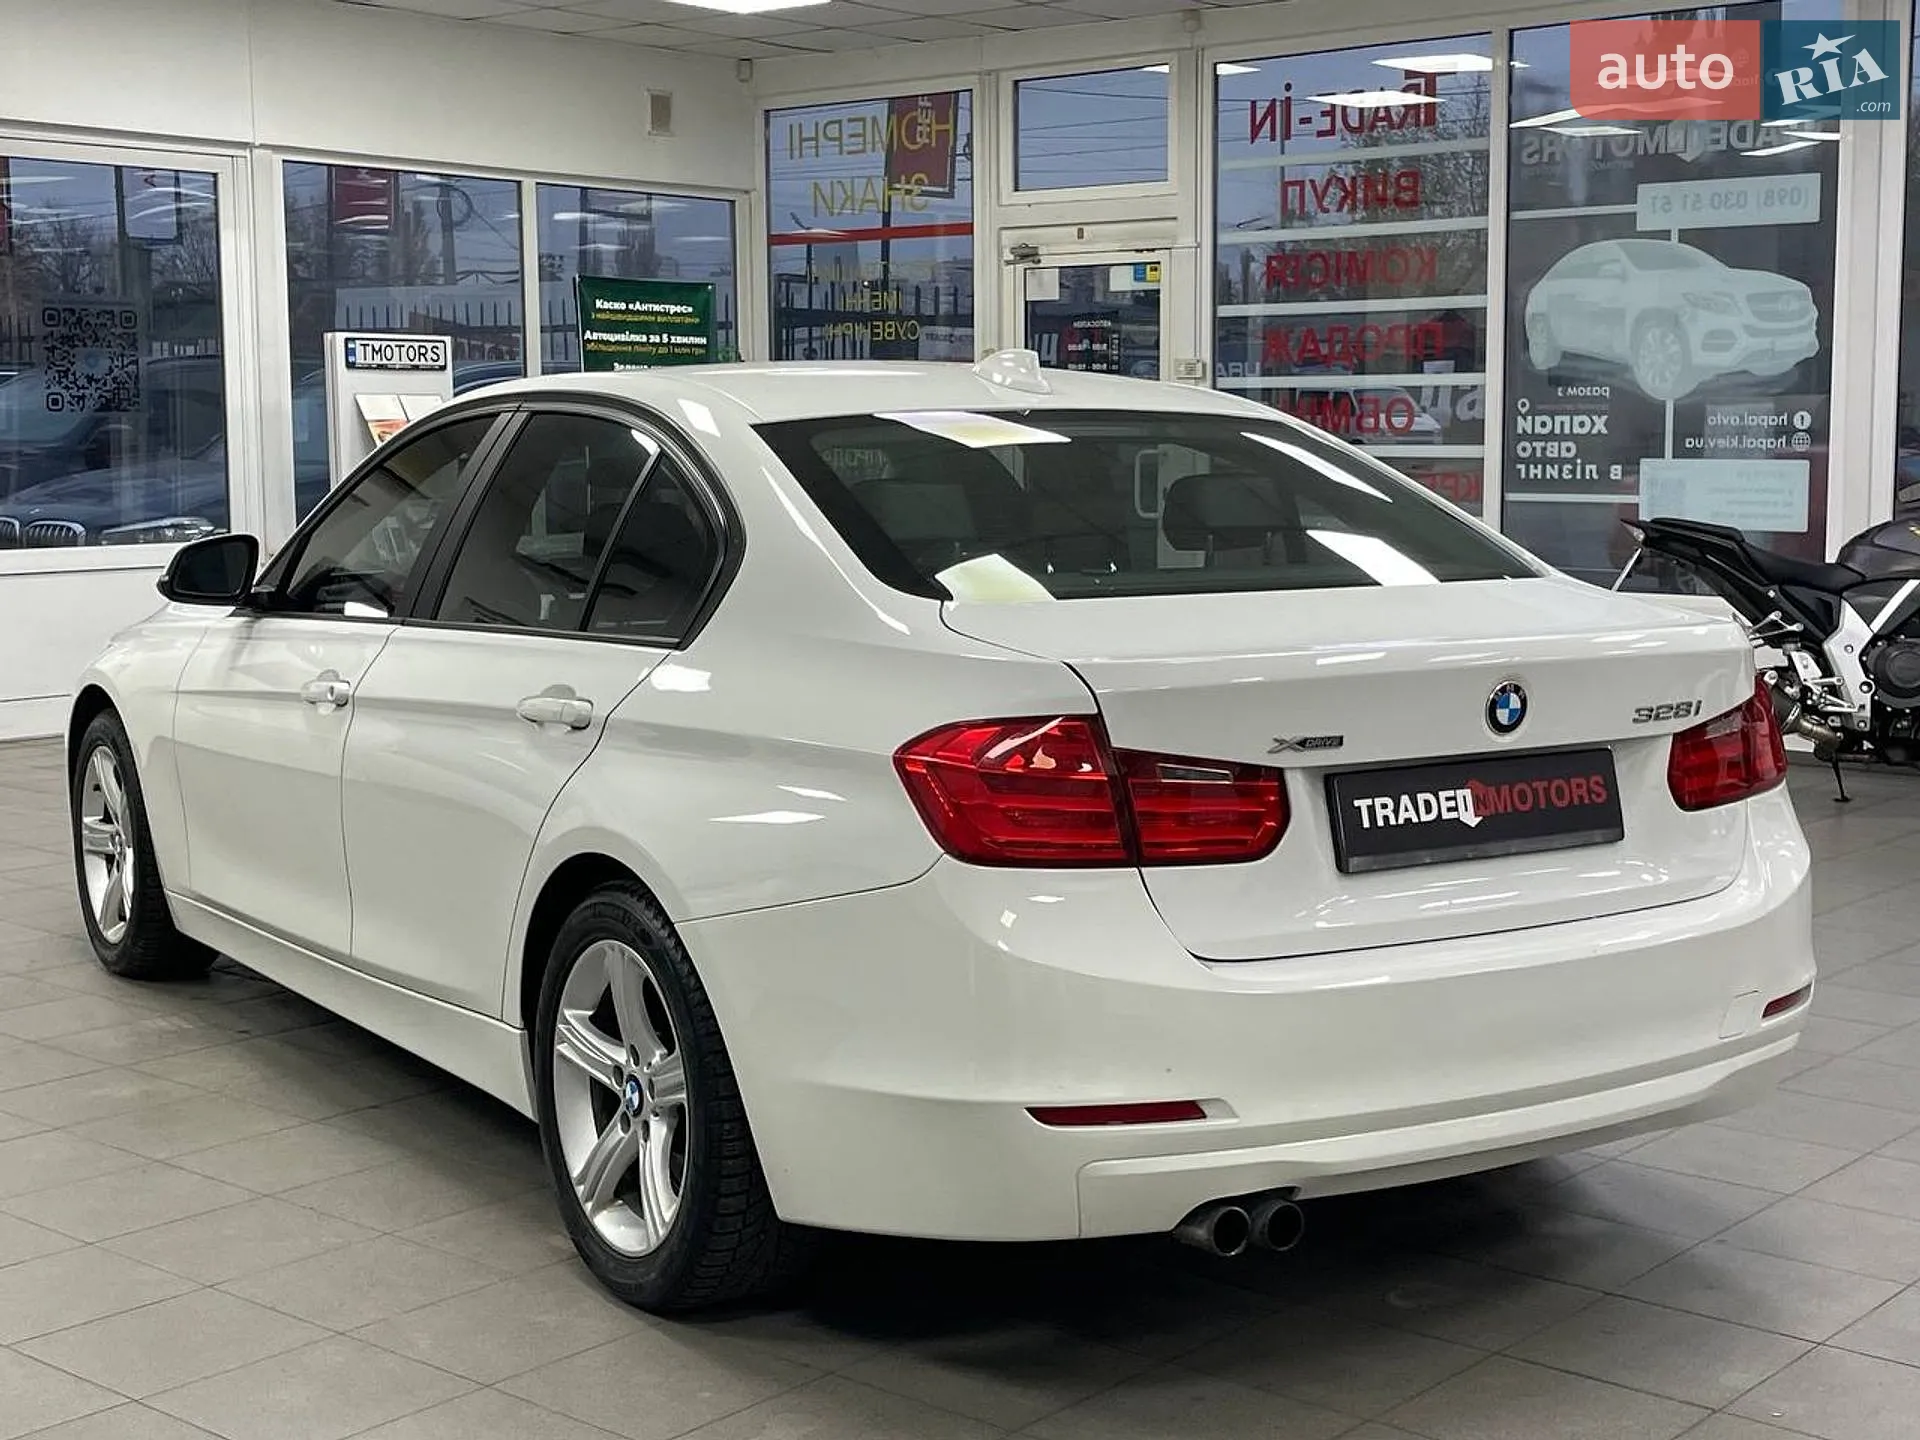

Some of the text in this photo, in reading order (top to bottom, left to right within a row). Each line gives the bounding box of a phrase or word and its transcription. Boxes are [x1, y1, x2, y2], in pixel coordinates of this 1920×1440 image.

[595, 299, 626, 310] Каско
[583, 330, 707, 345] Автоцивілка за 5 хвилин
[360, 343, 441, 362] TMOTORS
